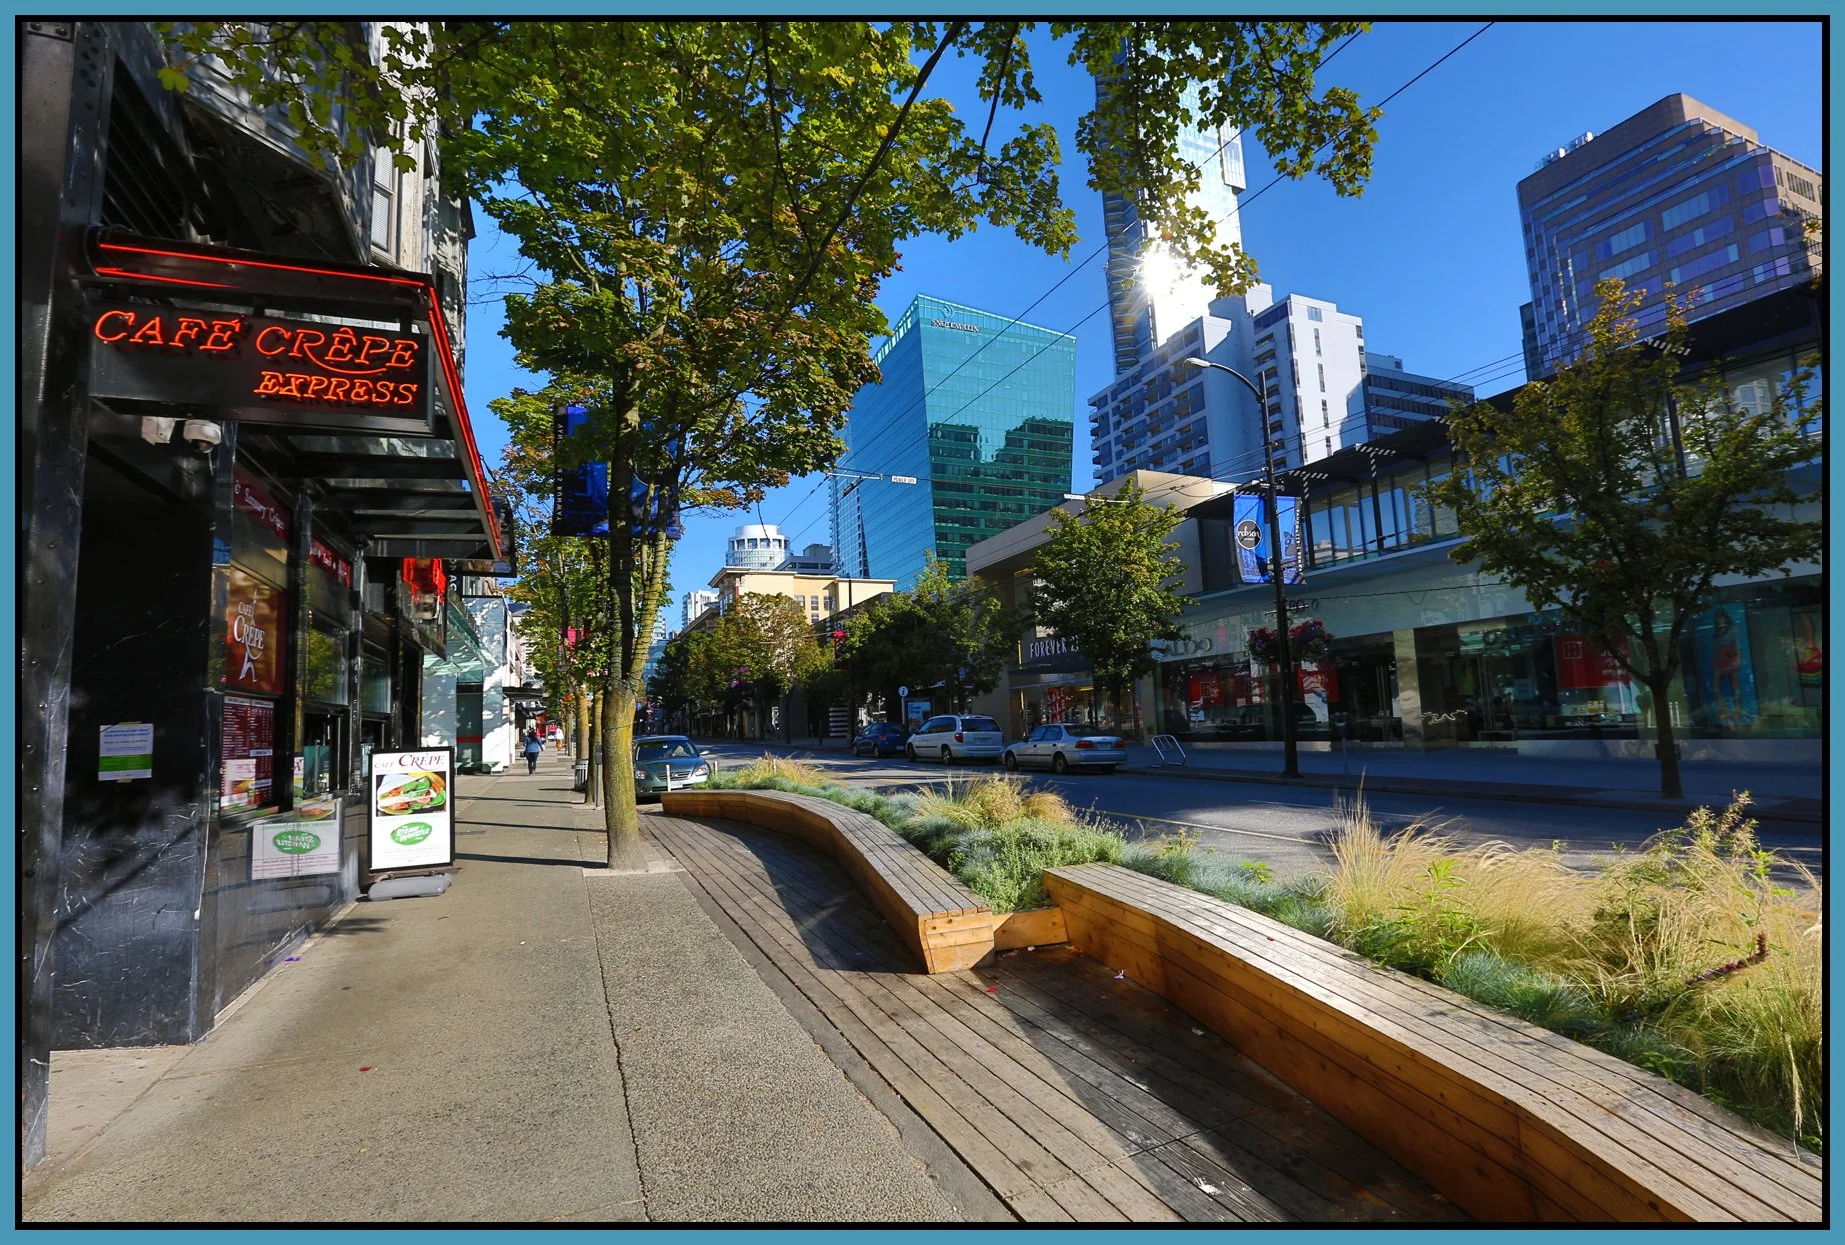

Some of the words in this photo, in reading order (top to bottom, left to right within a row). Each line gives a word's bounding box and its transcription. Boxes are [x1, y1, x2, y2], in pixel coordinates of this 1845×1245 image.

[94, 309, 243, 352] CAFÉ
[255, 327, 420, 375] CRÊPE
[253, 371, 420, 405] EXPRESS
[1030, 637, 1068, 658] FOREVER
